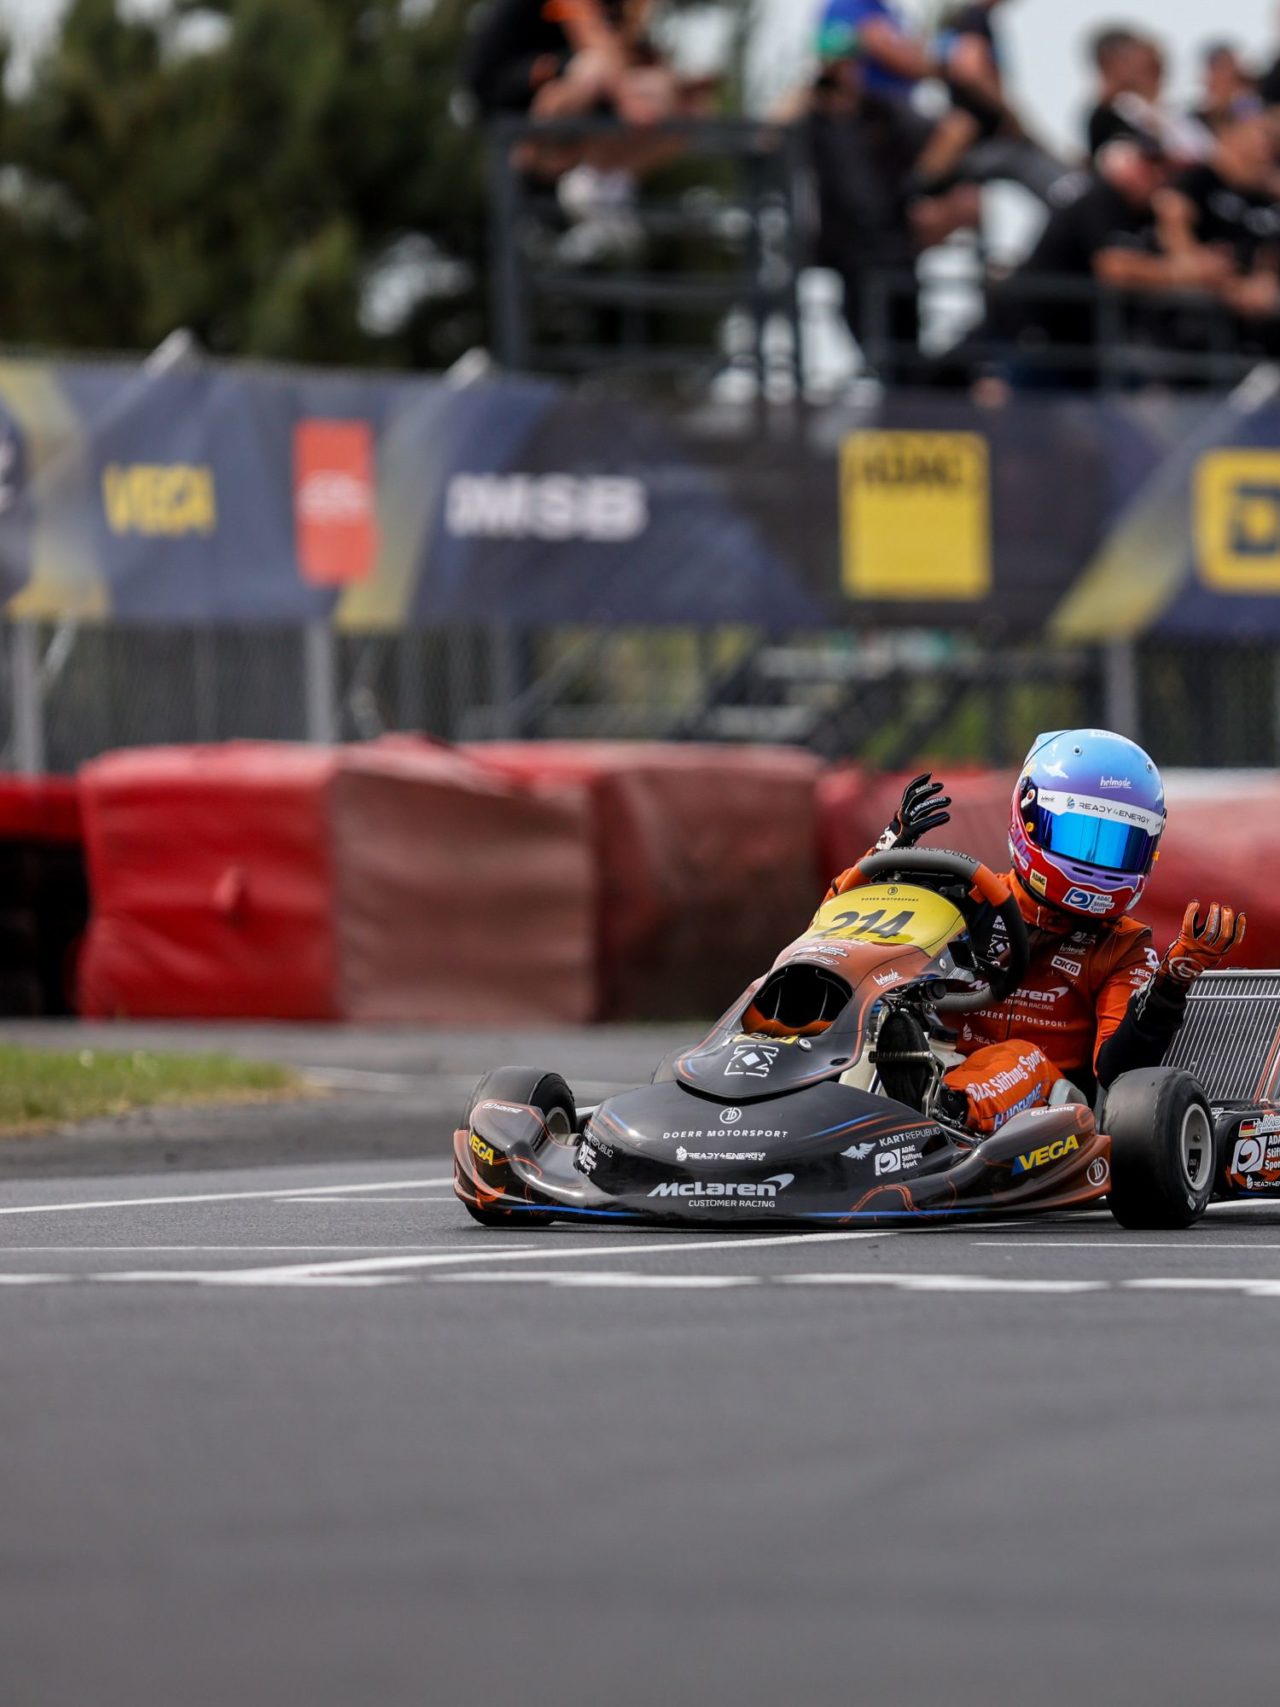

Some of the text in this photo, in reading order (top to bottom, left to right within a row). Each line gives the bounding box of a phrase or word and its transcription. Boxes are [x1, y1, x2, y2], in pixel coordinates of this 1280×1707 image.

[105, 463, 214, 537] VEGA
[1100, 776, 1131, 788] helmade
[815, 909, 915, 939] 214
[1054, 959, 1079, 974] DKM
[663, 1129, 788, 1139] DOERR MOTORSPORT
[901, 1144, 916, 1154] ADAC
[1018, 1134, 1080, 1171] VEGA
[902, 1160, 918, 1169] Sport
[647, 1181, 776, 1197] McLaren
[688, 1199, 776, 1208] CUSTOMER RACING
